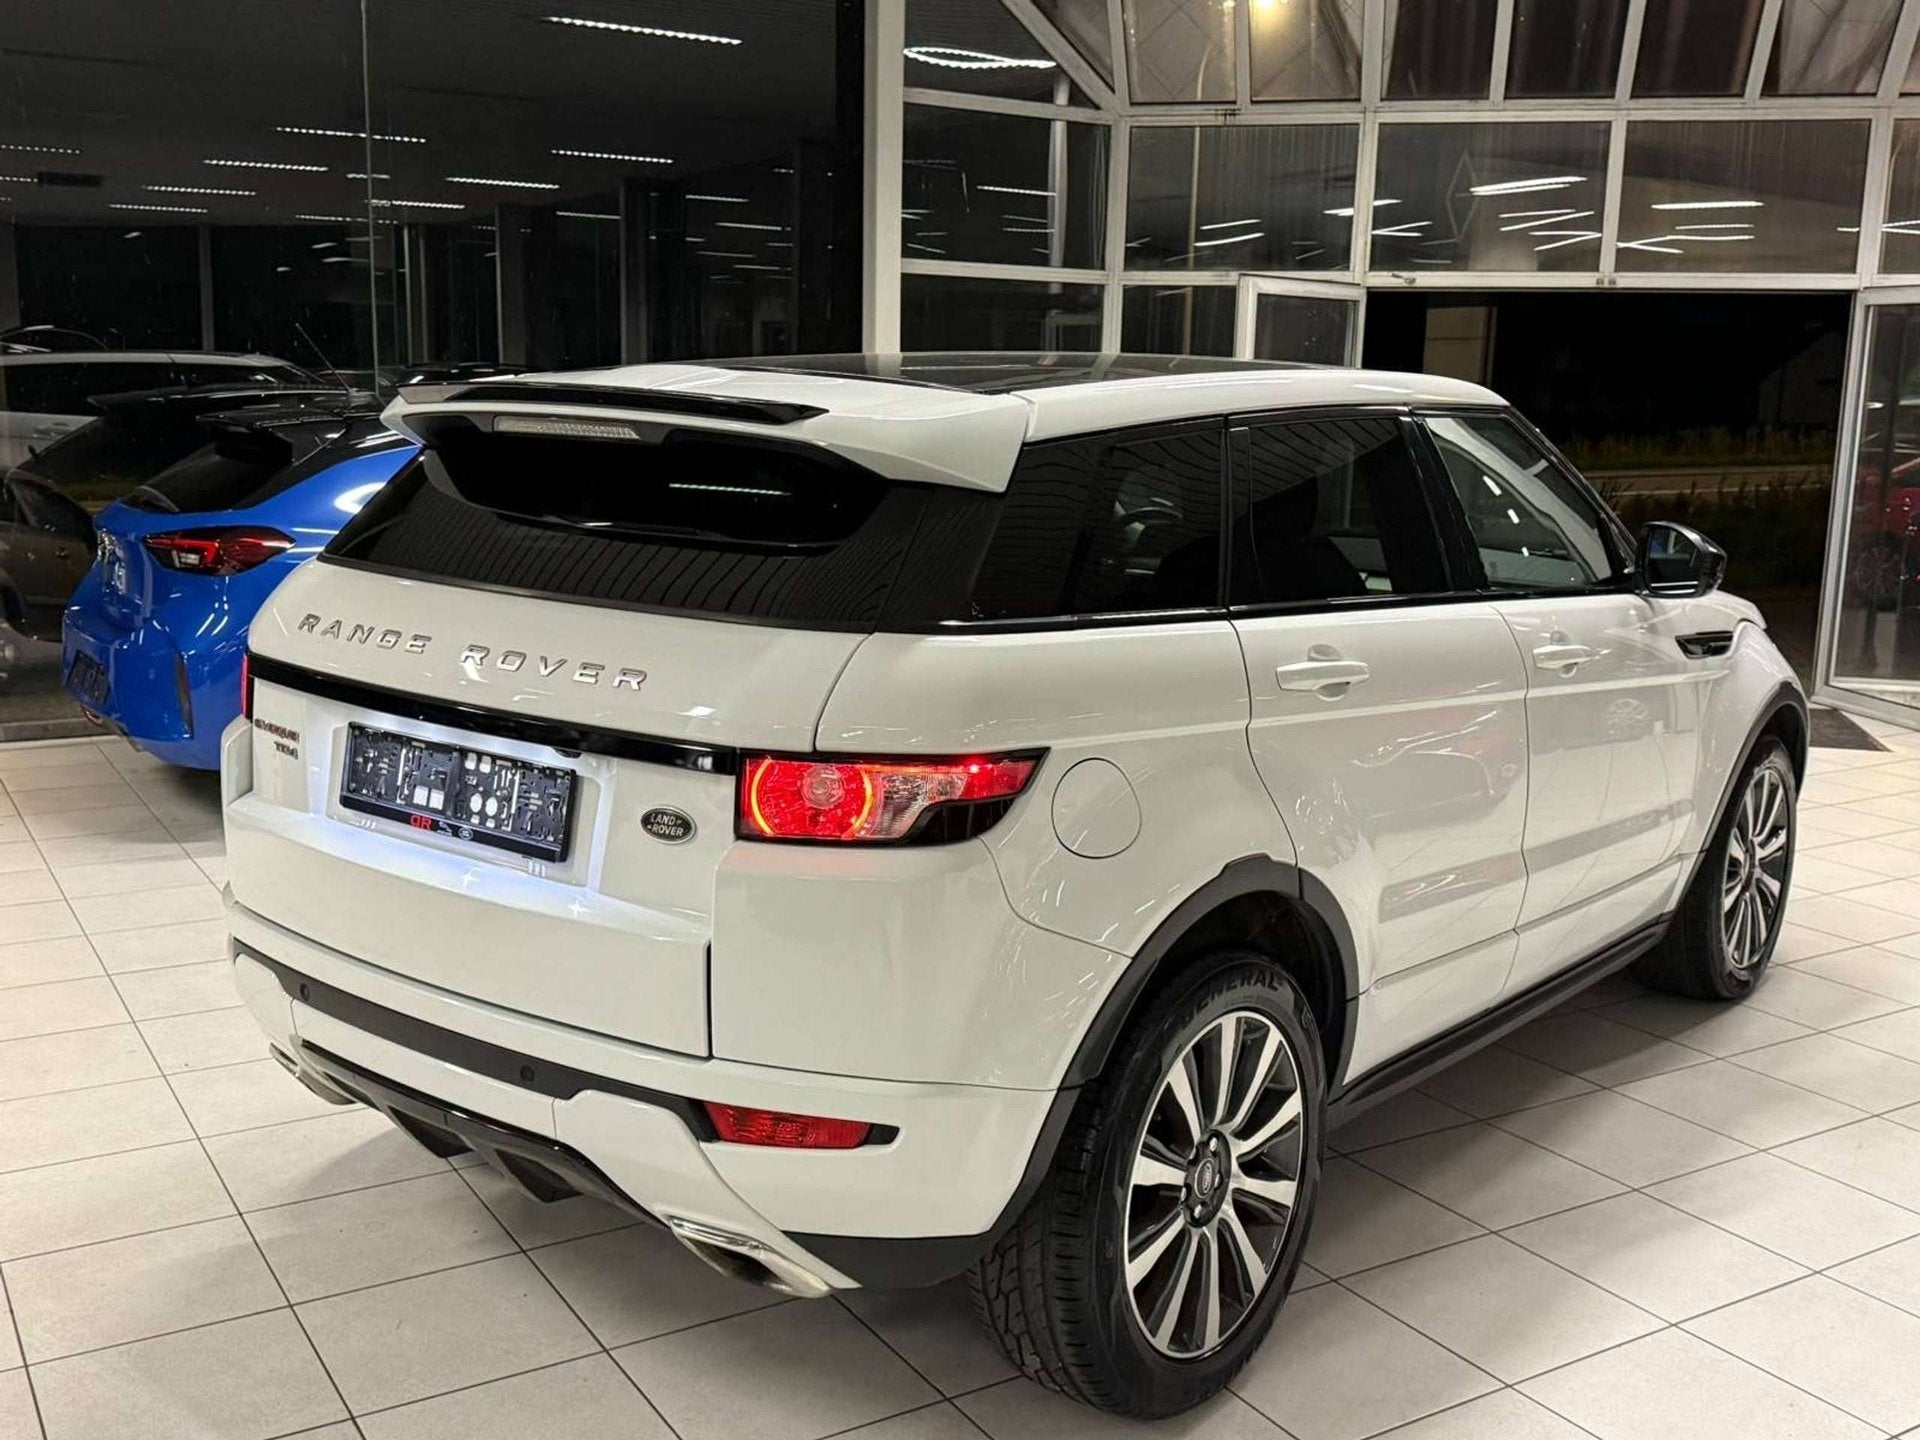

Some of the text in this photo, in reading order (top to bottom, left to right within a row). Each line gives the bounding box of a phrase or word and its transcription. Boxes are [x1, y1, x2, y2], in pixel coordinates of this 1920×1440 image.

[298, 612, 647, 691] RANGE ROVER
[650, 813, 676, 826] LAND
[651, 824, 684, 837] ROVER
